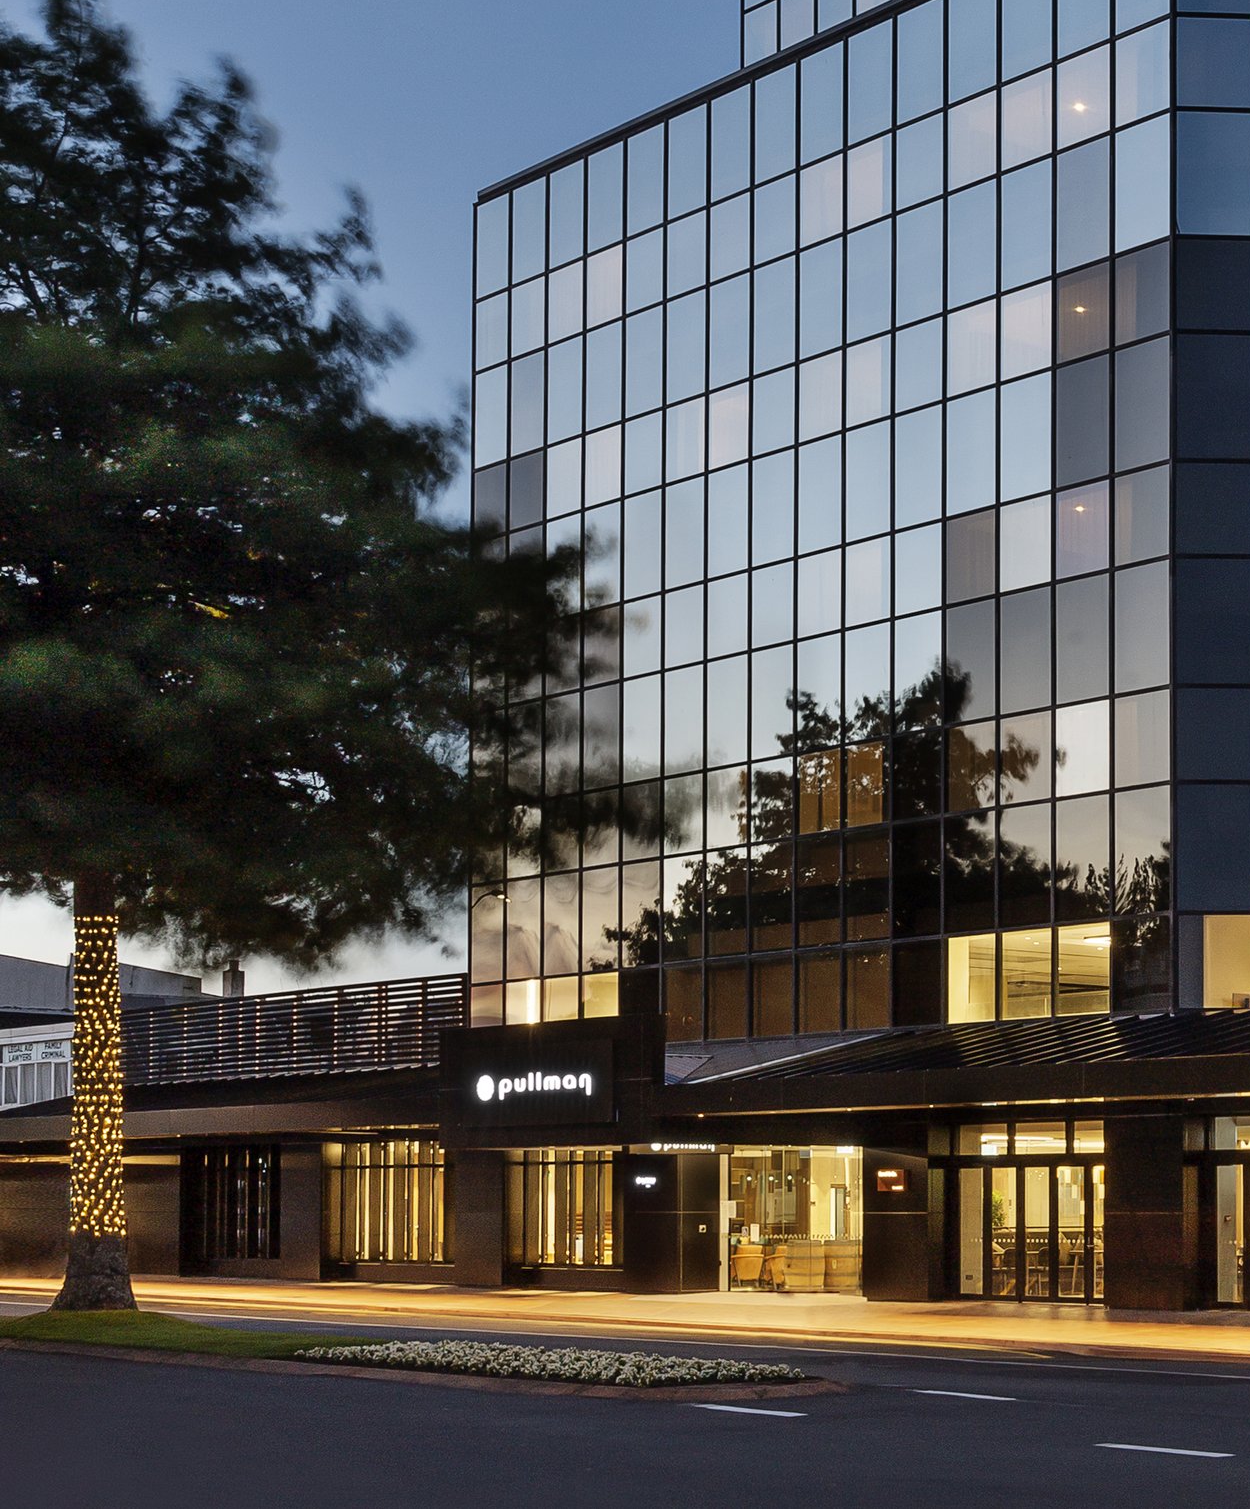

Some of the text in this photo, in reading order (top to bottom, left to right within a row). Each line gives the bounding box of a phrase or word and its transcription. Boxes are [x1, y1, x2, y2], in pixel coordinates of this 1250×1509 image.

[8, 1045, 23, 1053] LEGAL
[44, 1042, 62, 1050] FAMILY
[9, 1053, 32, 1062] LAWYERS
[41, 1051, 66, 1059] CRIMINAL
[498, 1071, 592, 1101] pullman
